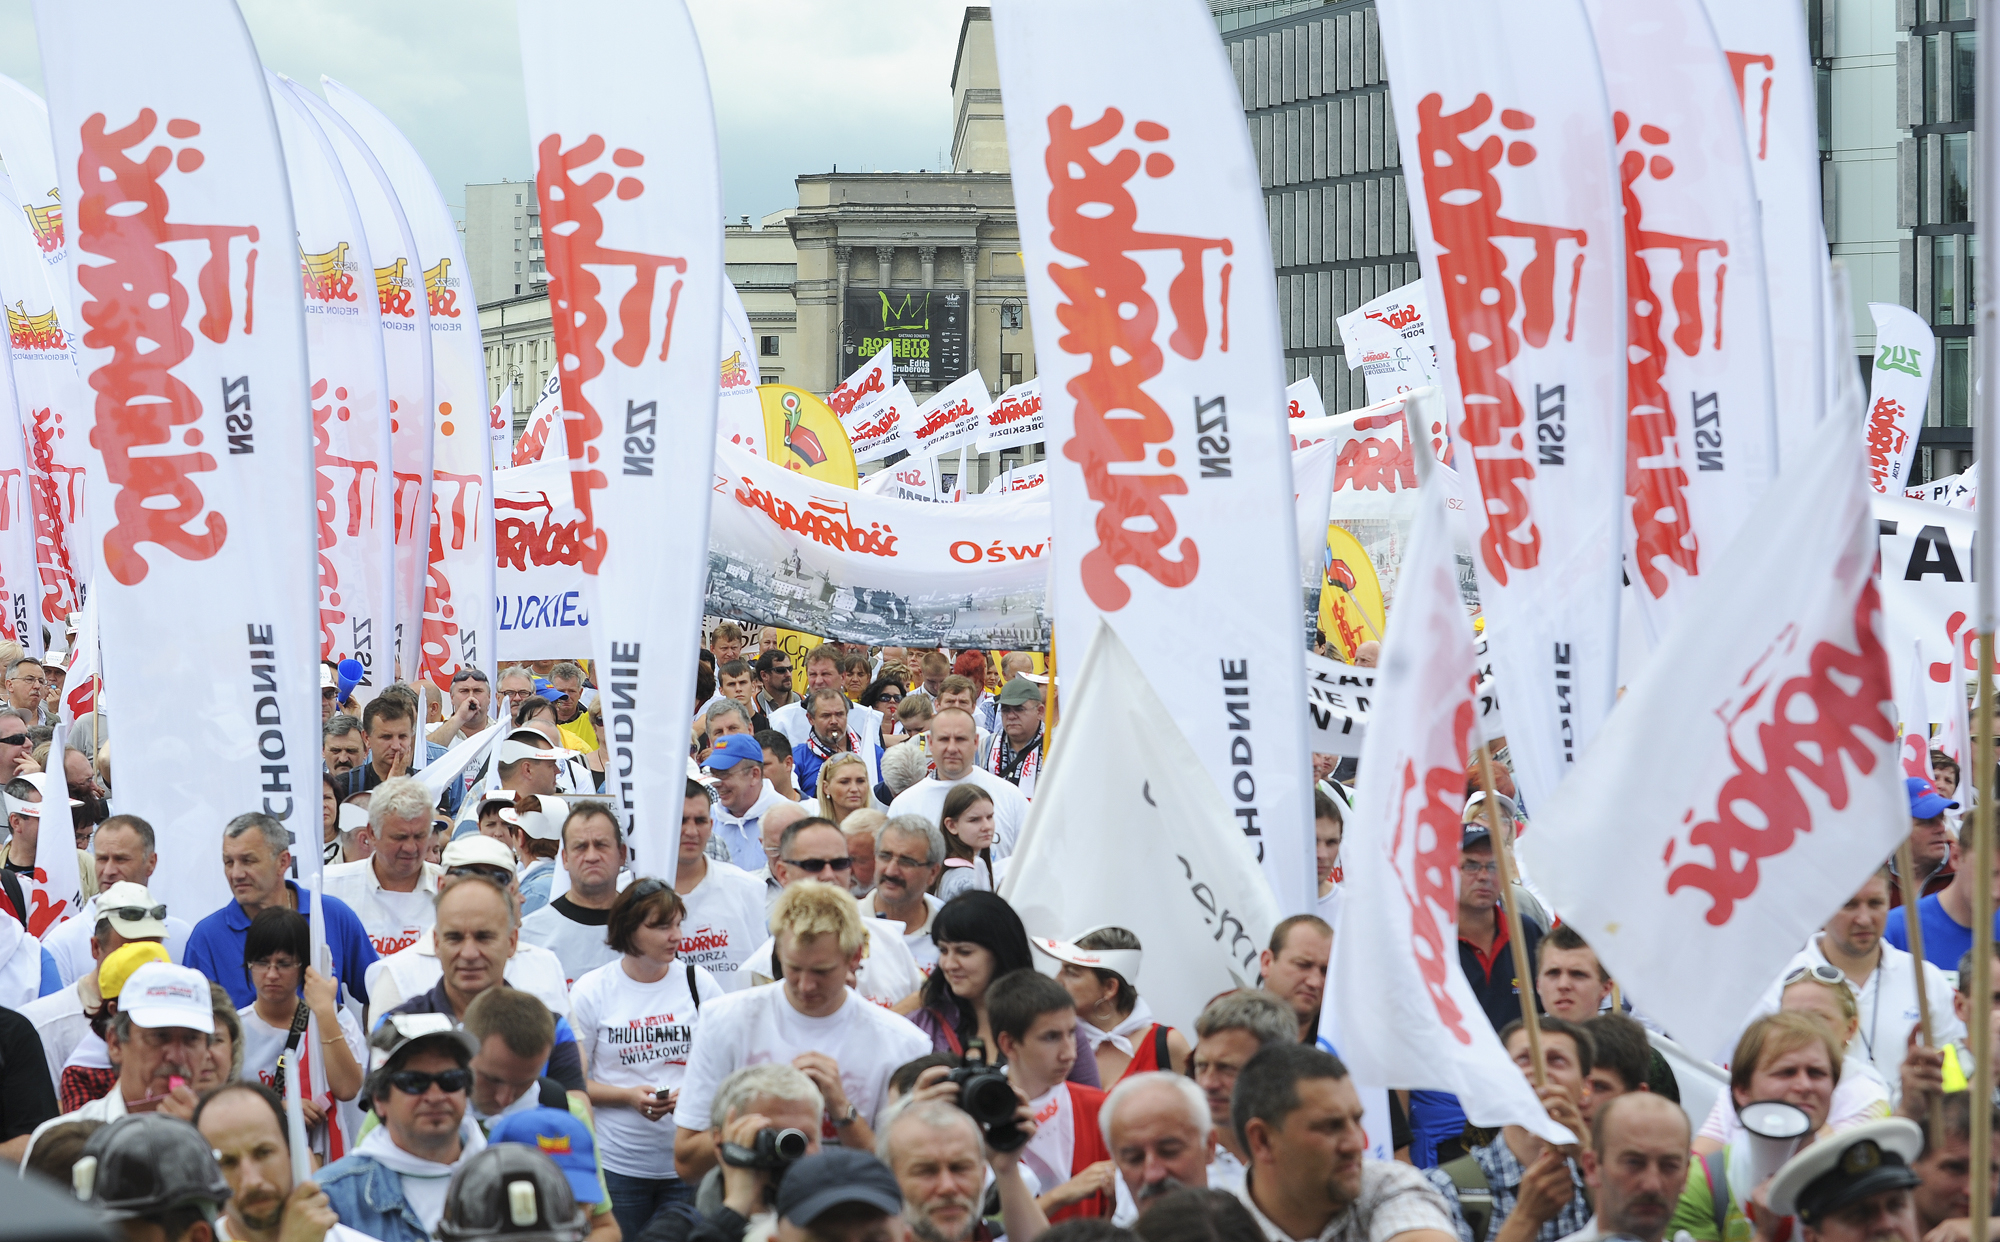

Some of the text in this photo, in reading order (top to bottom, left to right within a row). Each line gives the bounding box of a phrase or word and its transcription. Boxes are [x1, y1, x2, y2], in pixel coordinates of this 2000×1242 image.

[909, 359, 930, 367] Edita
[494, 591, 588, 630] LICKIEJ
[681, 951, 728, 965] OMORZA
[629, 1013, 675, 1029] NIE JESTEM
[608, 1026, 691, 1044] CHULIGANEM
